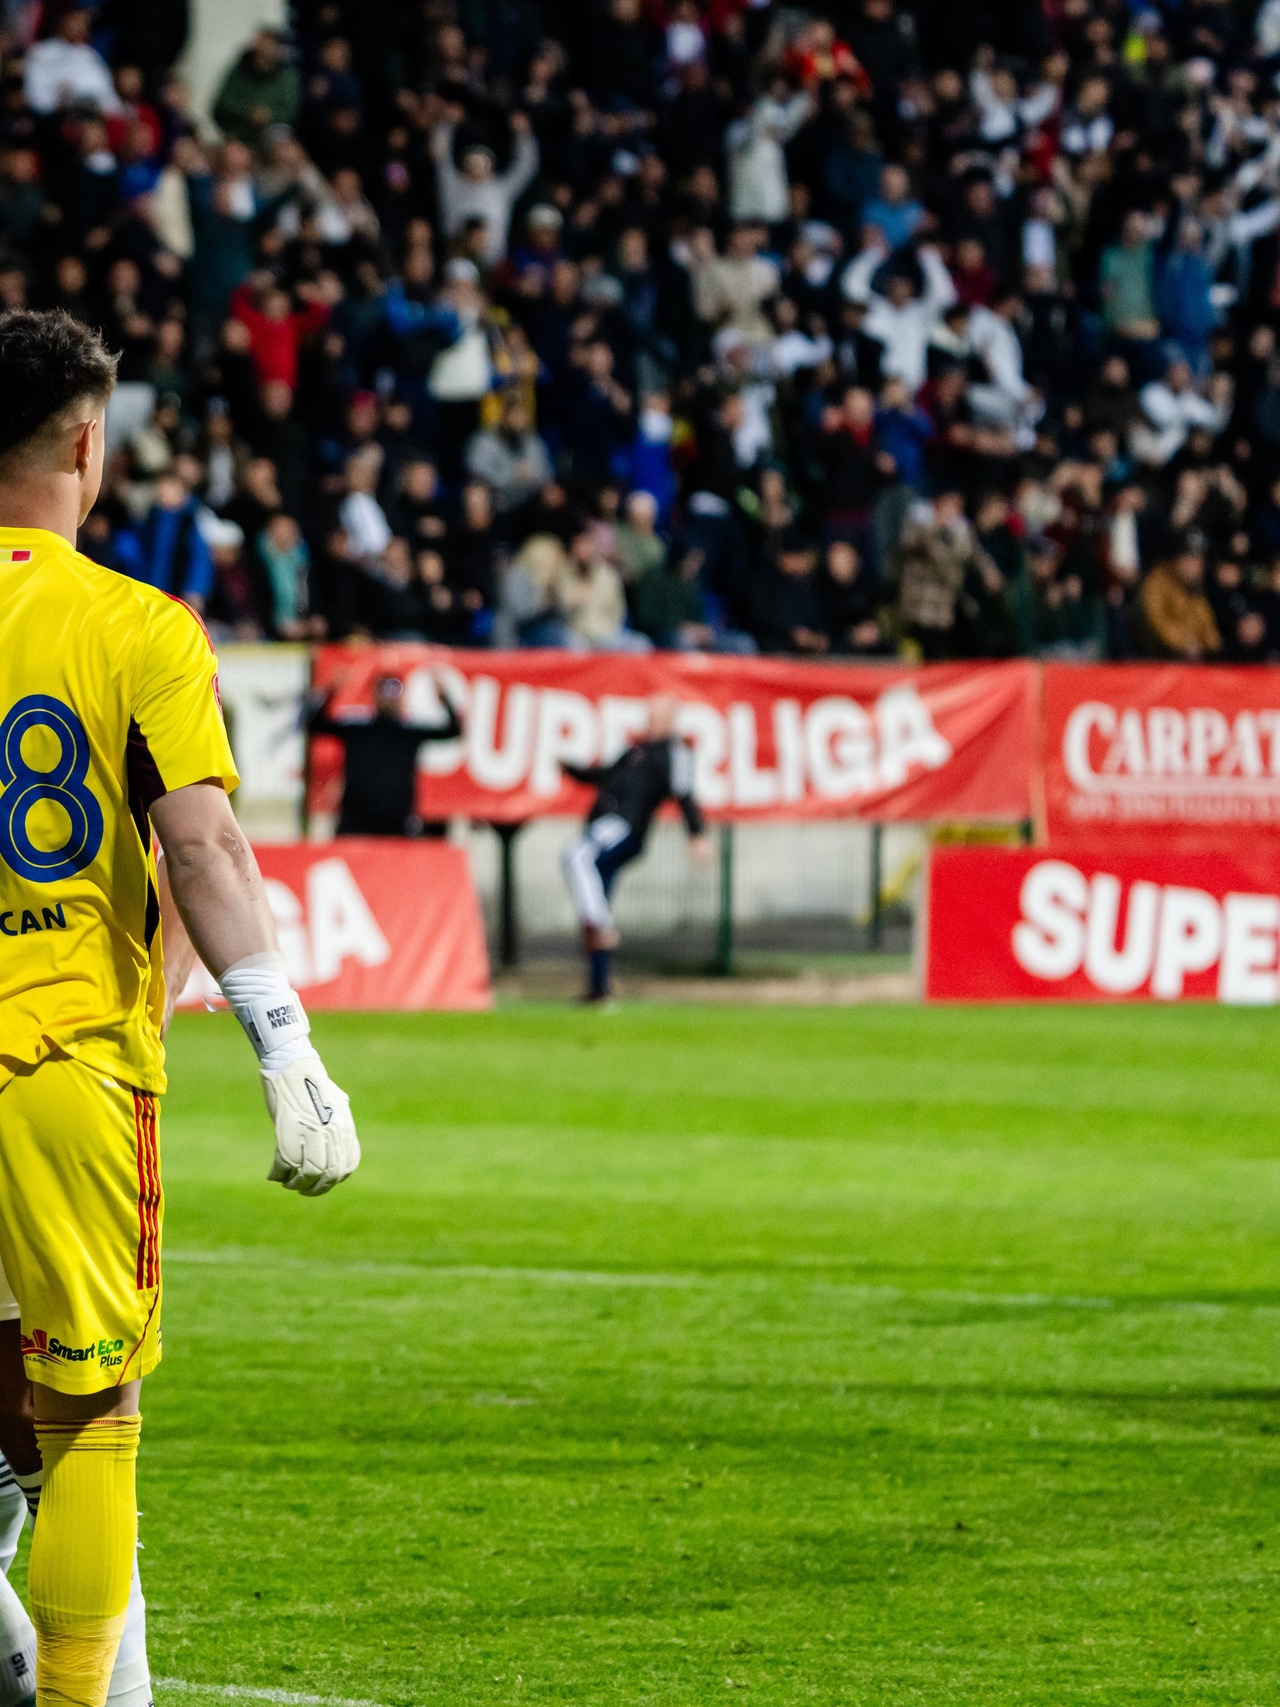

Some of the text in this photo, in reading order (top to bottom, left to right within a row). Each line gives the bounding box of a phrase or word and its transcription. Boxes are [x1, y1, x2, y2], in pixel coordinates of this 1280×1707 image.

[47, 1337, 124, 1362] Smart Eco
[99, 1354, 123, 1368] Plus
